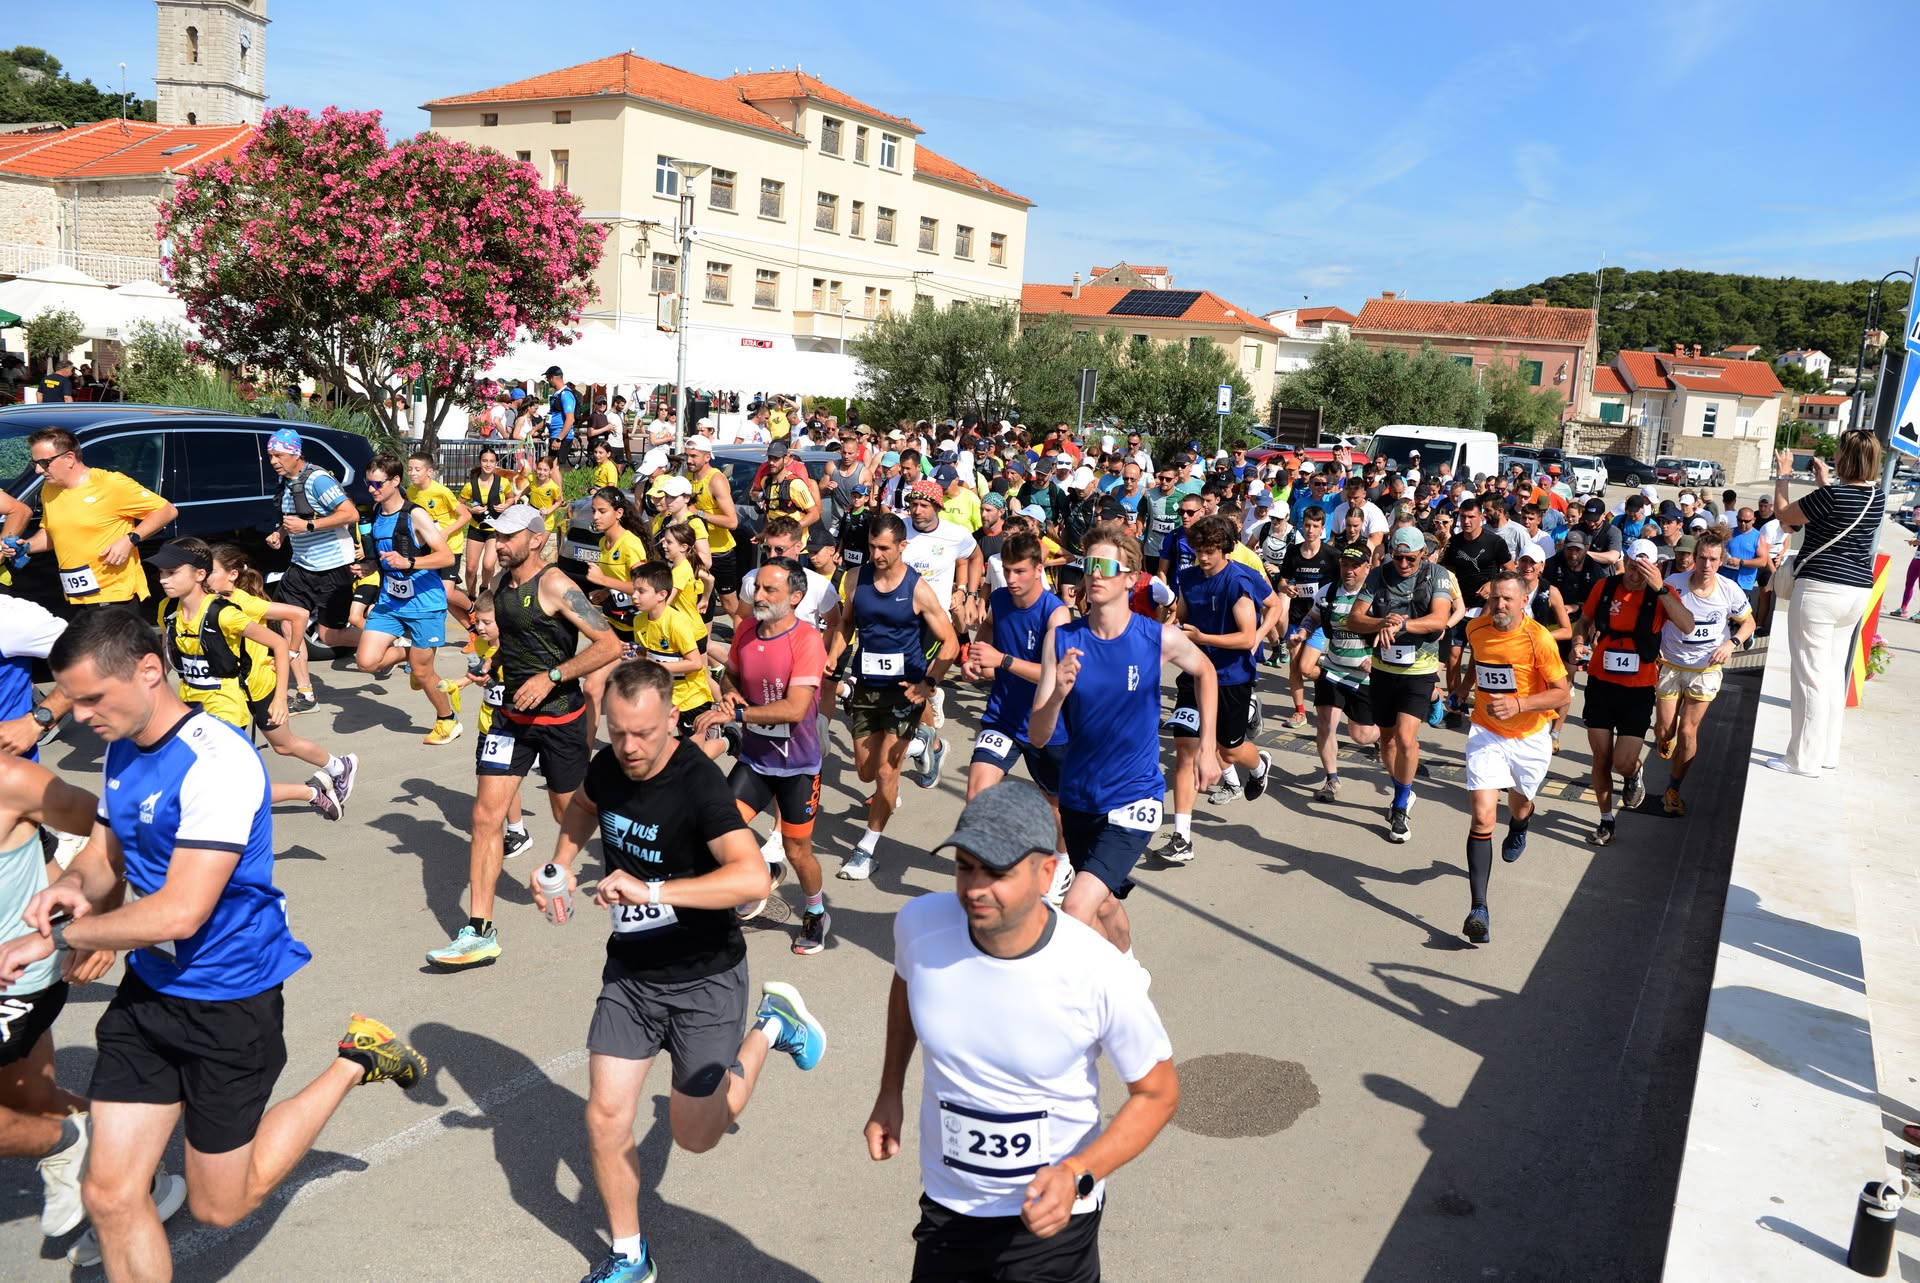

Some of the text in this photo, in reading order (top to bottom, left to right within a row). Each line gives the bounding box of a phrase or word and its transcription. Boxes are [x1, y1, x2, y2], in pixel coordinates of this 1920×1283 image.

[1158, 523, 1171, 532] 154
[68, 575, 90, 589] 195
[1303, 586, 1314, 595] 118
[1694, 628, 1709, 638] 48
[1395, 650, 1402, 659] 5
[878, 659, 892, 671] 15
[1616, 657, 1630, 668] 14
[1485, 672, 1508, 685] 153
[1174, 711, 1195, 724] 156
[980, 733, 1004, 749] 168
[1127, 805, 1157, 824] 163
[630, 820, 660, 842] VUŠ
[624, 842, 664, 864] TRAIL
[967, 1128, 1032, 1159] 239
